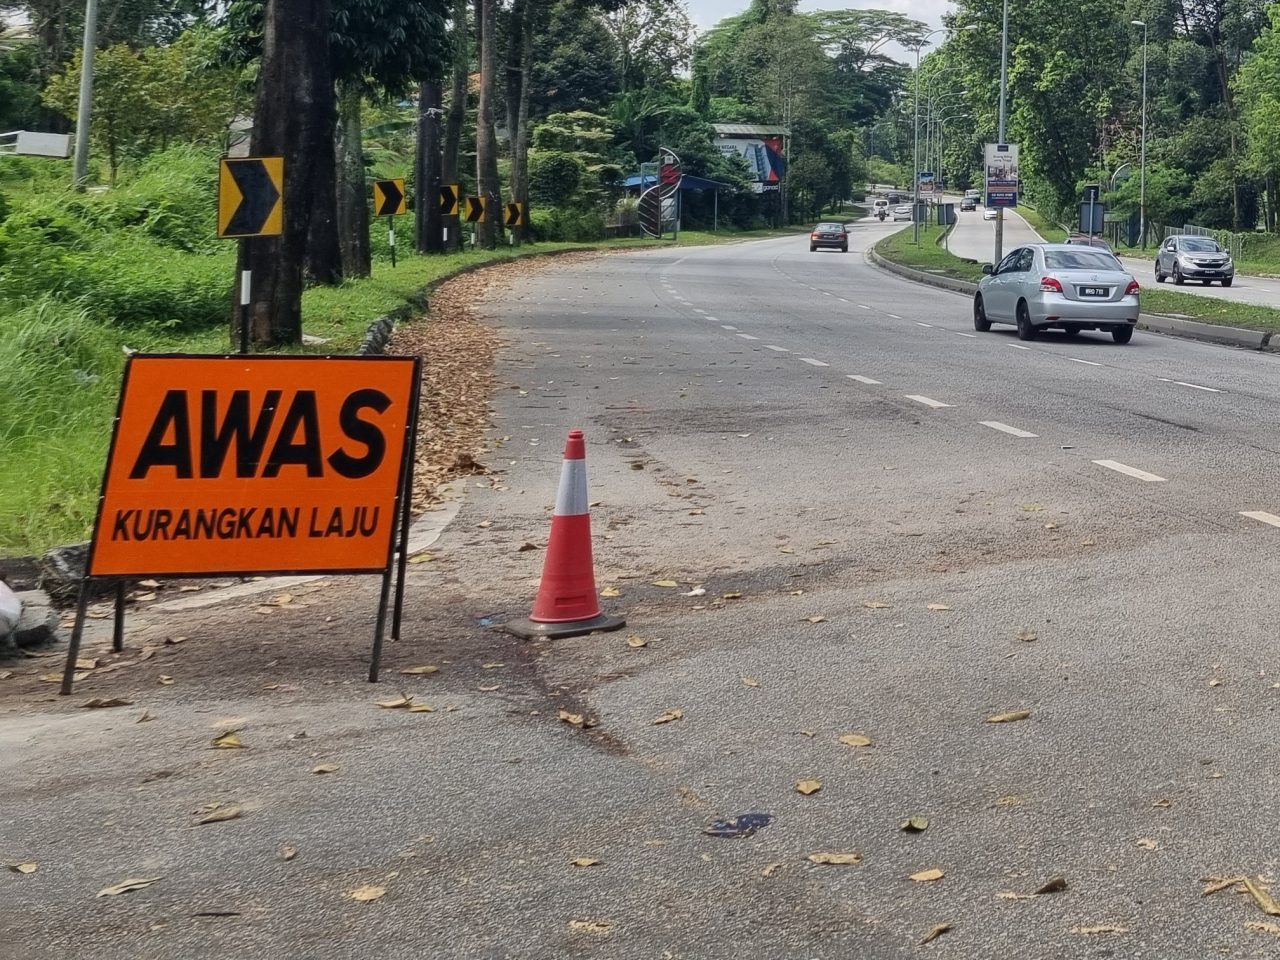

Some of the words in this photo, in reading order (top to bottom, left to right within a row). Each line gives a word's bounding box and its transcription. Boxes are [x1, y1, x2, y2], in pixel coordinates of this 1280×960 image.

[128, 388, 393, 480] AWAS
[111, 506, 301, 542] KURANGKAN
[308, 506, 381, 539] LAJU
